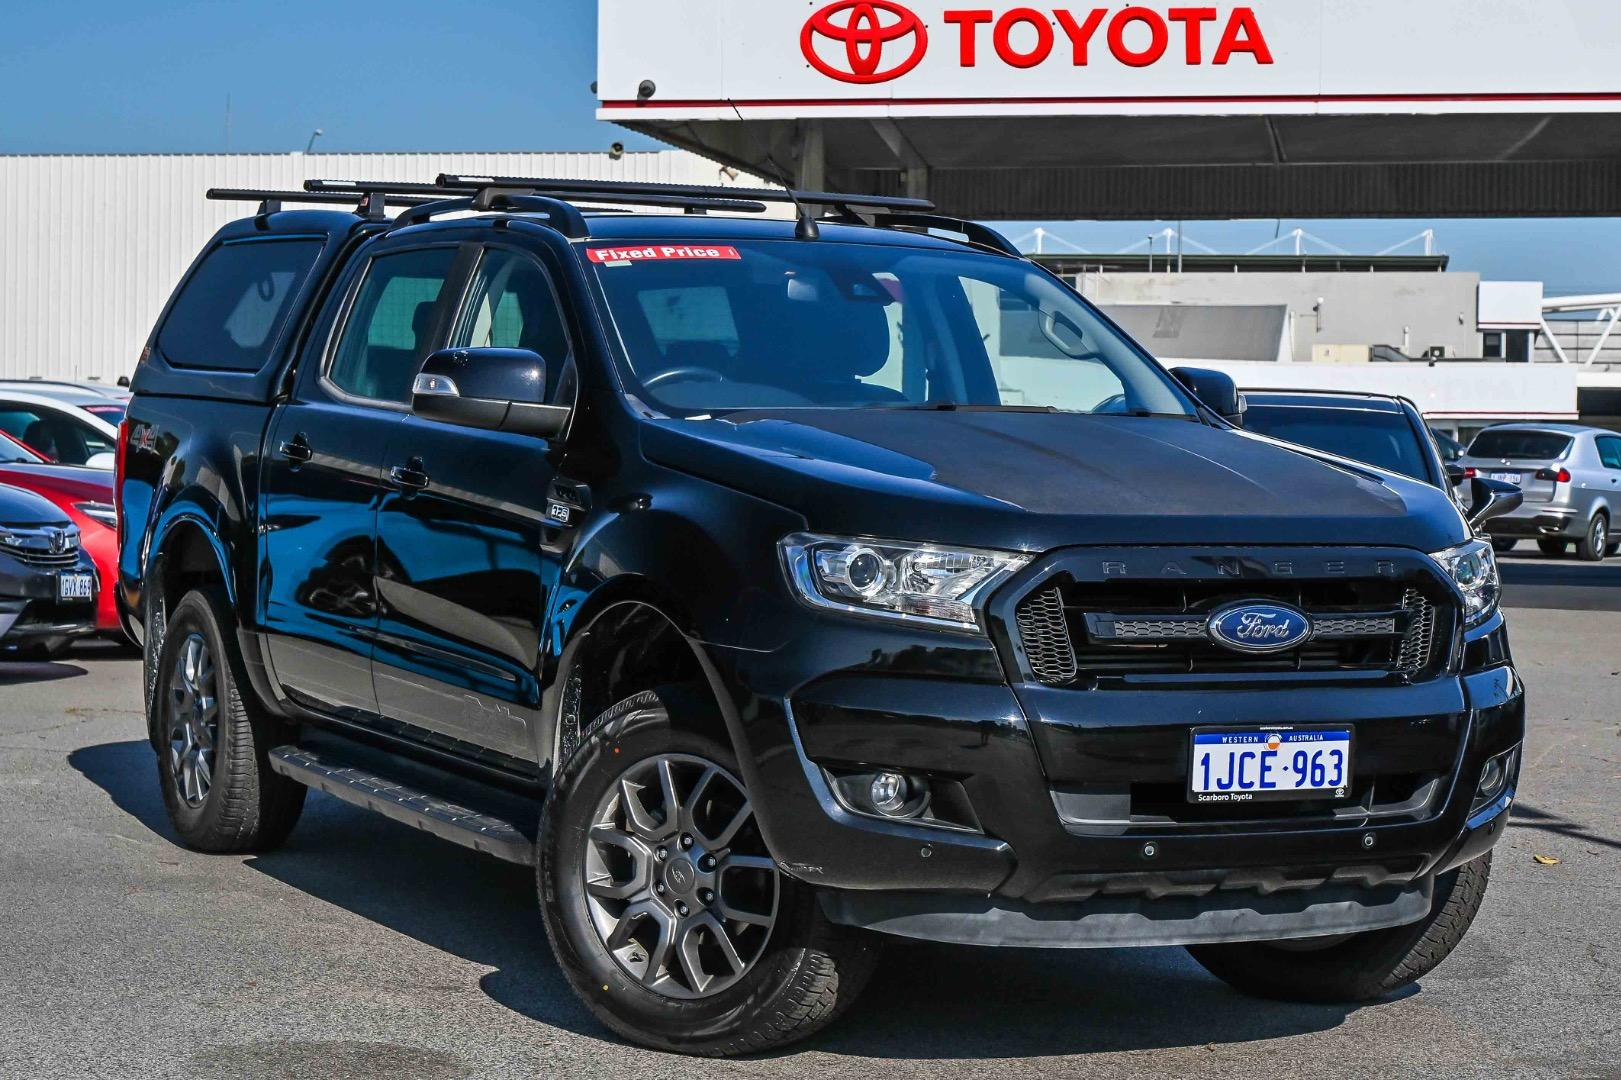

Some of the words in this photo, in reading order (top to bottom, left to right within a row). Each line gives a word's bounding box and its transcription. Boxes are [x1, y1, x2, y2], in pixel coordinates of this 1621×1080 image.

[943, 6, 1274, 69] TOYOTA
[594, 247, 657, 261] Fixed
[660, 246, 721, 258] Price
[1102, 560, 1395, 575] RANGER
[1236, 612, 1291, 639] Ford
[1288, 734, 1324, 742] AUSTRALIA
[1198, 793, 1229, 802] Scarboro
[1230, 792, 1253, 802] Toyota
